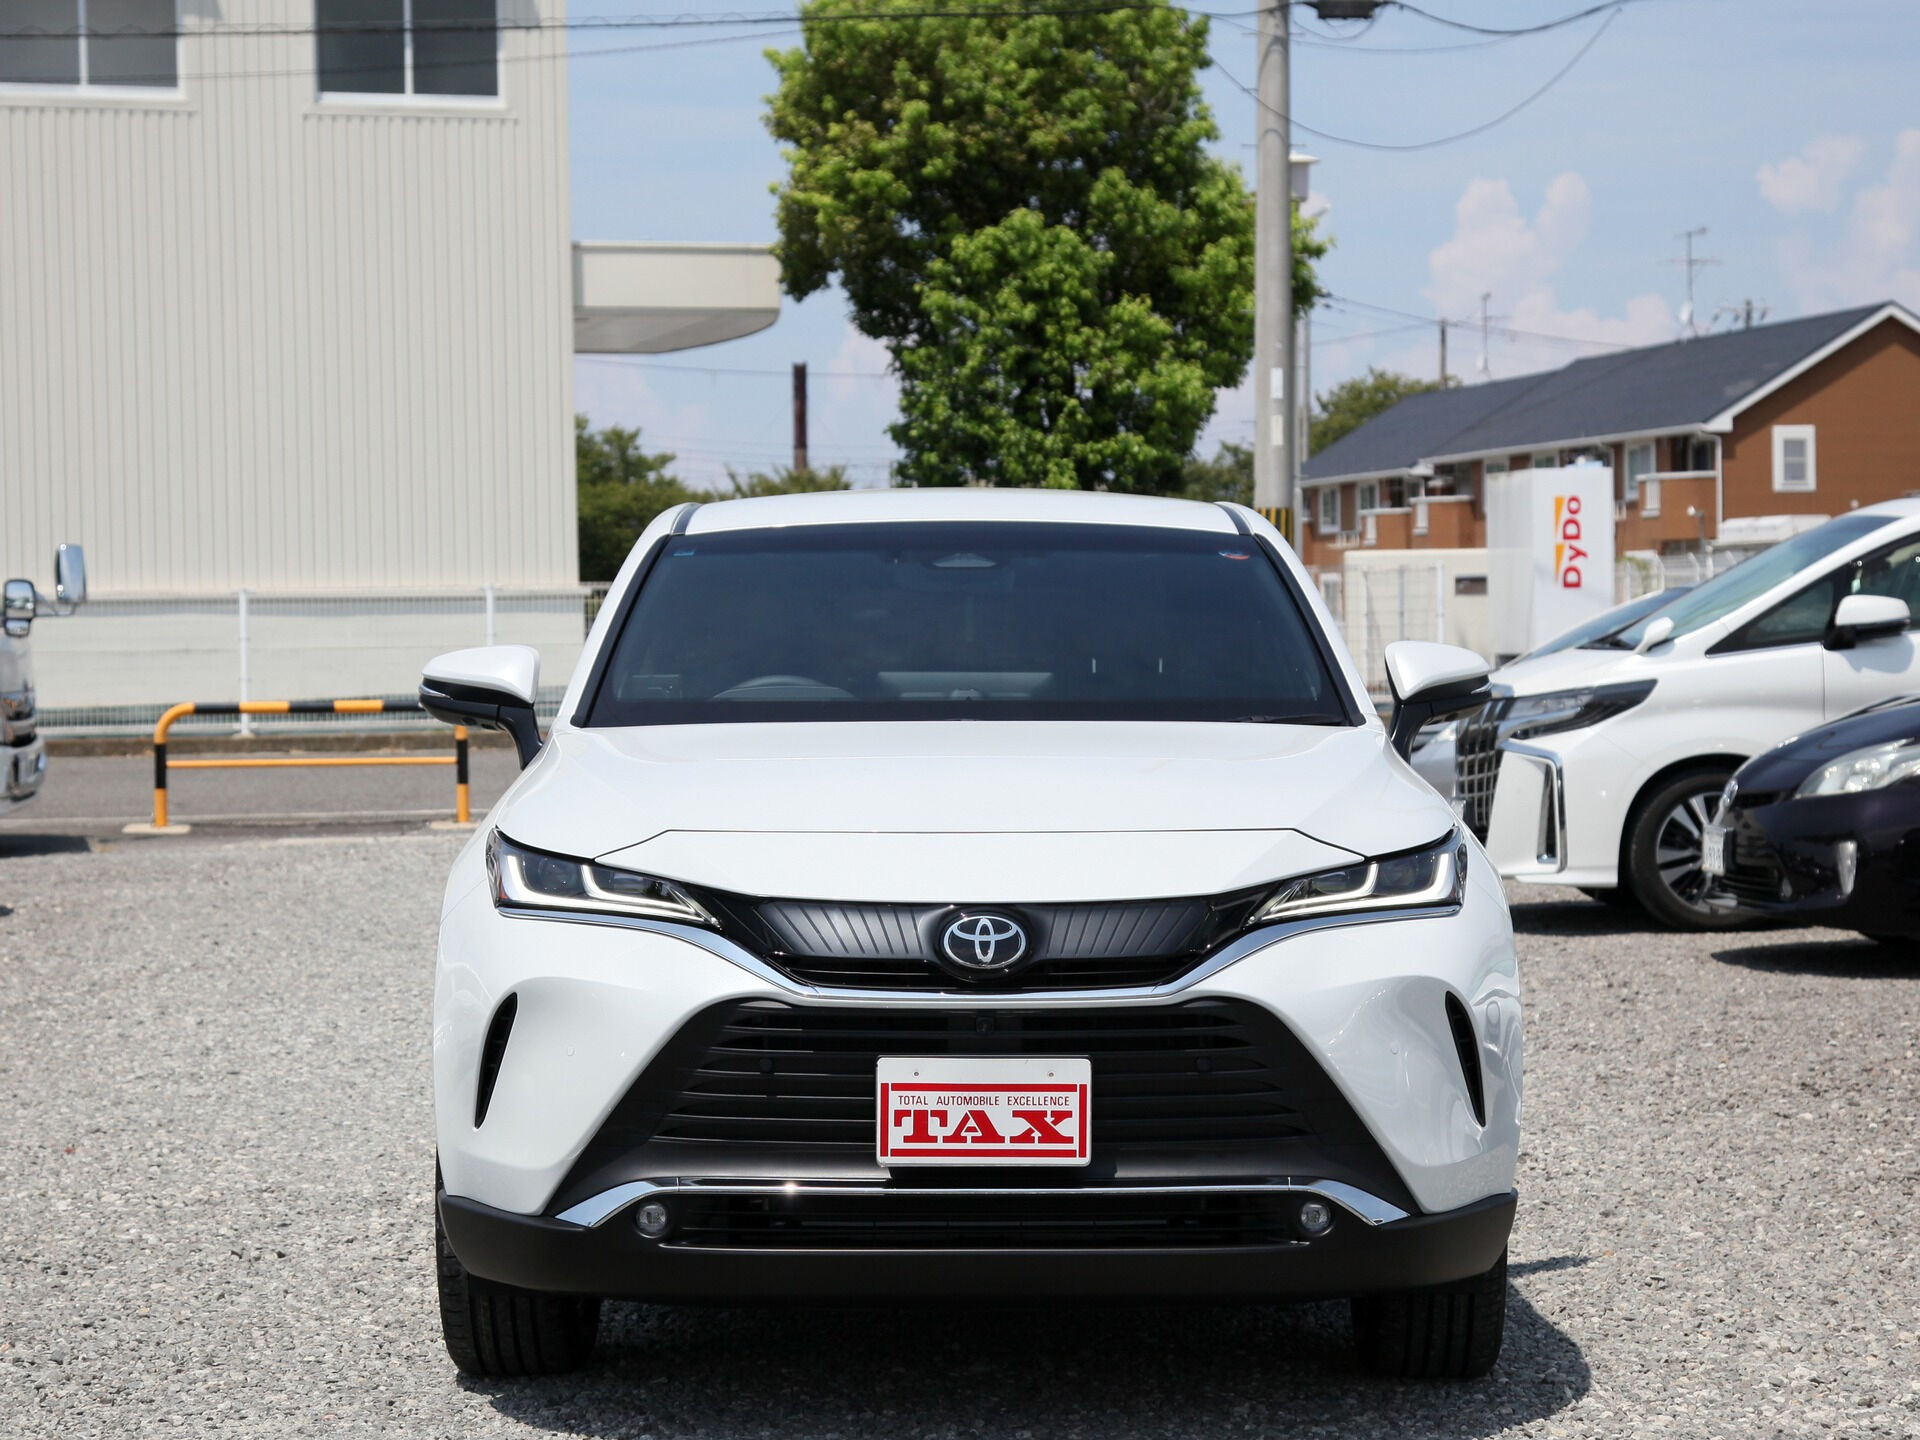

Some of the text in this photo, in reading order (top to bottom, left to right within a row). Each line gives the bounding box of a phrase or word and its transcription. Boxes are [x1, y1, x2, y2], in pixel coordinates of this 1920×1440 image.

[1563, 495, 1588, 588] DyDo
[898, 1095, 1070, 1106] TOTAL AUTOMOBILE EXCELLENCE
[893, 1109, 1074, 1144] TAX
